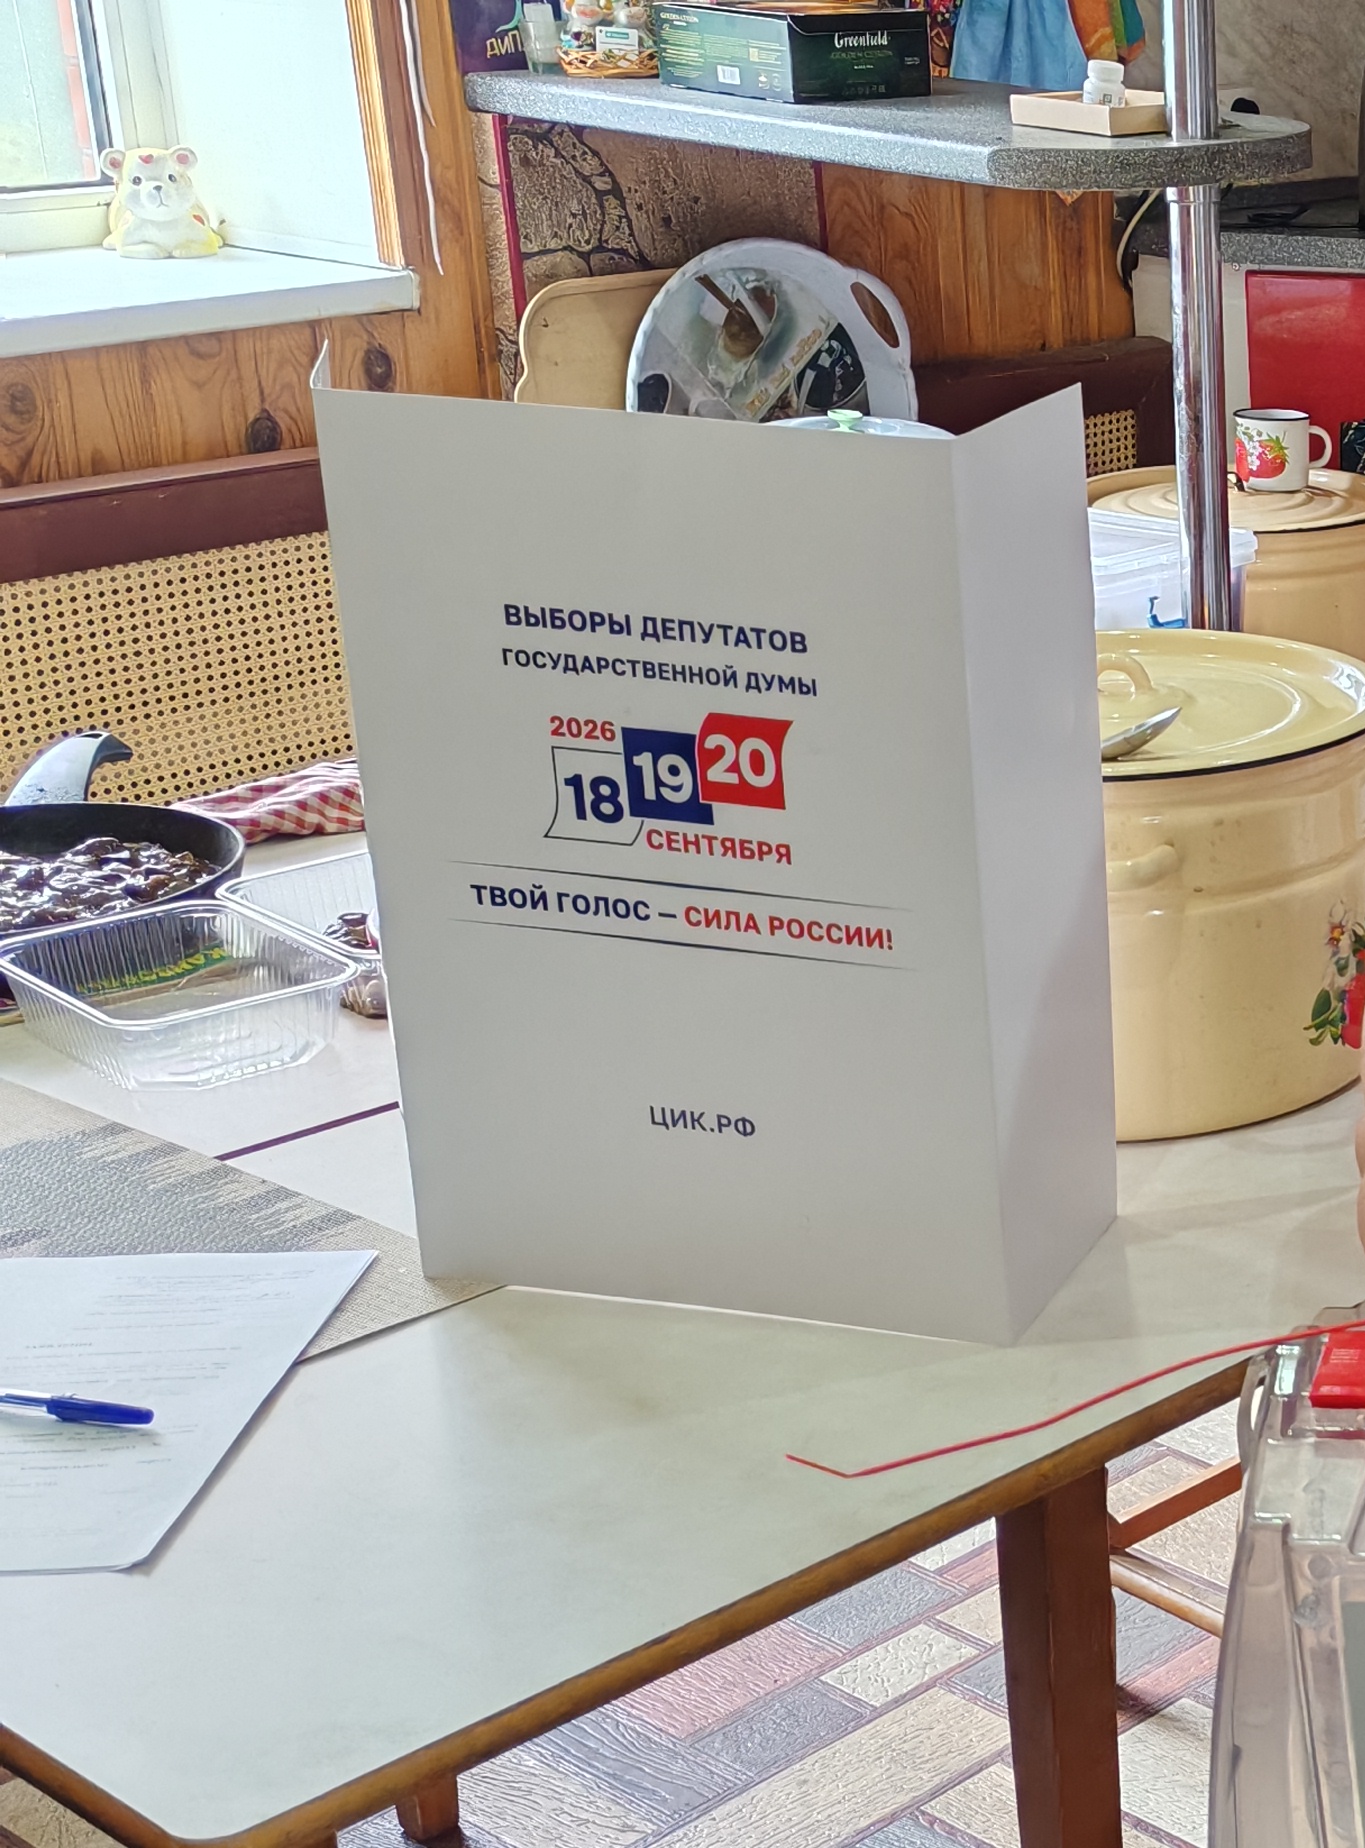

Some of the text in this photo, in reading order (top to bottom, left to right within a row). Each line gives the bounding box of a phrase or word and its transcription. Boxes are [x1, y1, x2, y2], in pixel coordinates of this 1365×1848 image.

[486, 30, 523, 59] ДИП
[503, 603, 808, 653] ВЫБОРЫ ДЕПУТАТОВ
[501, 648, 818, 697] ГОСУДАРСТВЕННОЙ ДУМЫ
[549, 715, 616, 742] 2026
[563, 733, 776, 824] 18 19 20
[646, 828, 792, 865] СЕНТЯБРЯ
[470, 883, 549, 913] ТВОЙ
[557, 892, 651, 922] ГОЛОС
[684, 905, 762, 935] СИЛА
[768, 916, 894, 951] РОССИИ!
[649, 1105, 756, 1137] ЦИК.РФ
